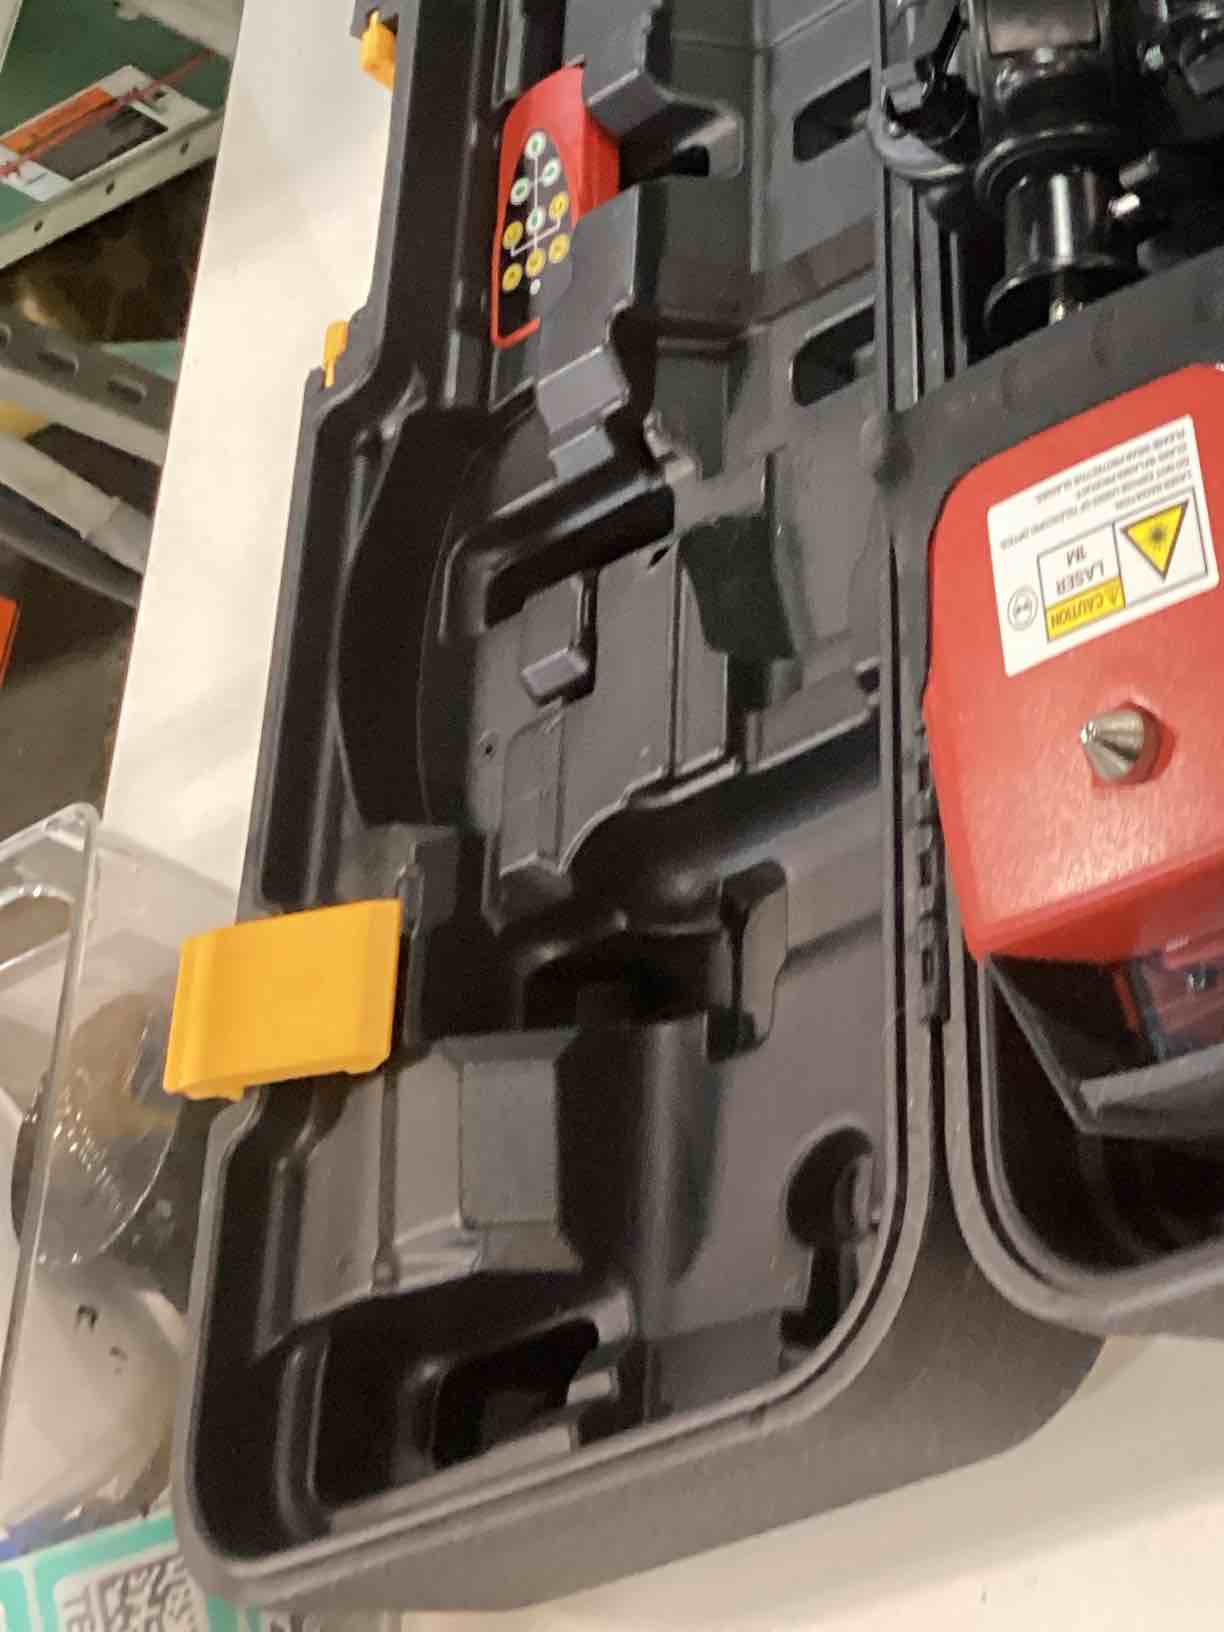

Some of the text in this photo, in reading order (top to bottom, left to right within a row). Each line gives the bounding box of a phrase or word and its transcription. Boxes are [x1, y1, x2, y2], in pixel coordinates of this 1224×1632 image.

[1066, 544, 1088, 566] 1M
[1055, 559, 1105, 597] LASER
[1049, 593, 1105, 630] CAUTION
